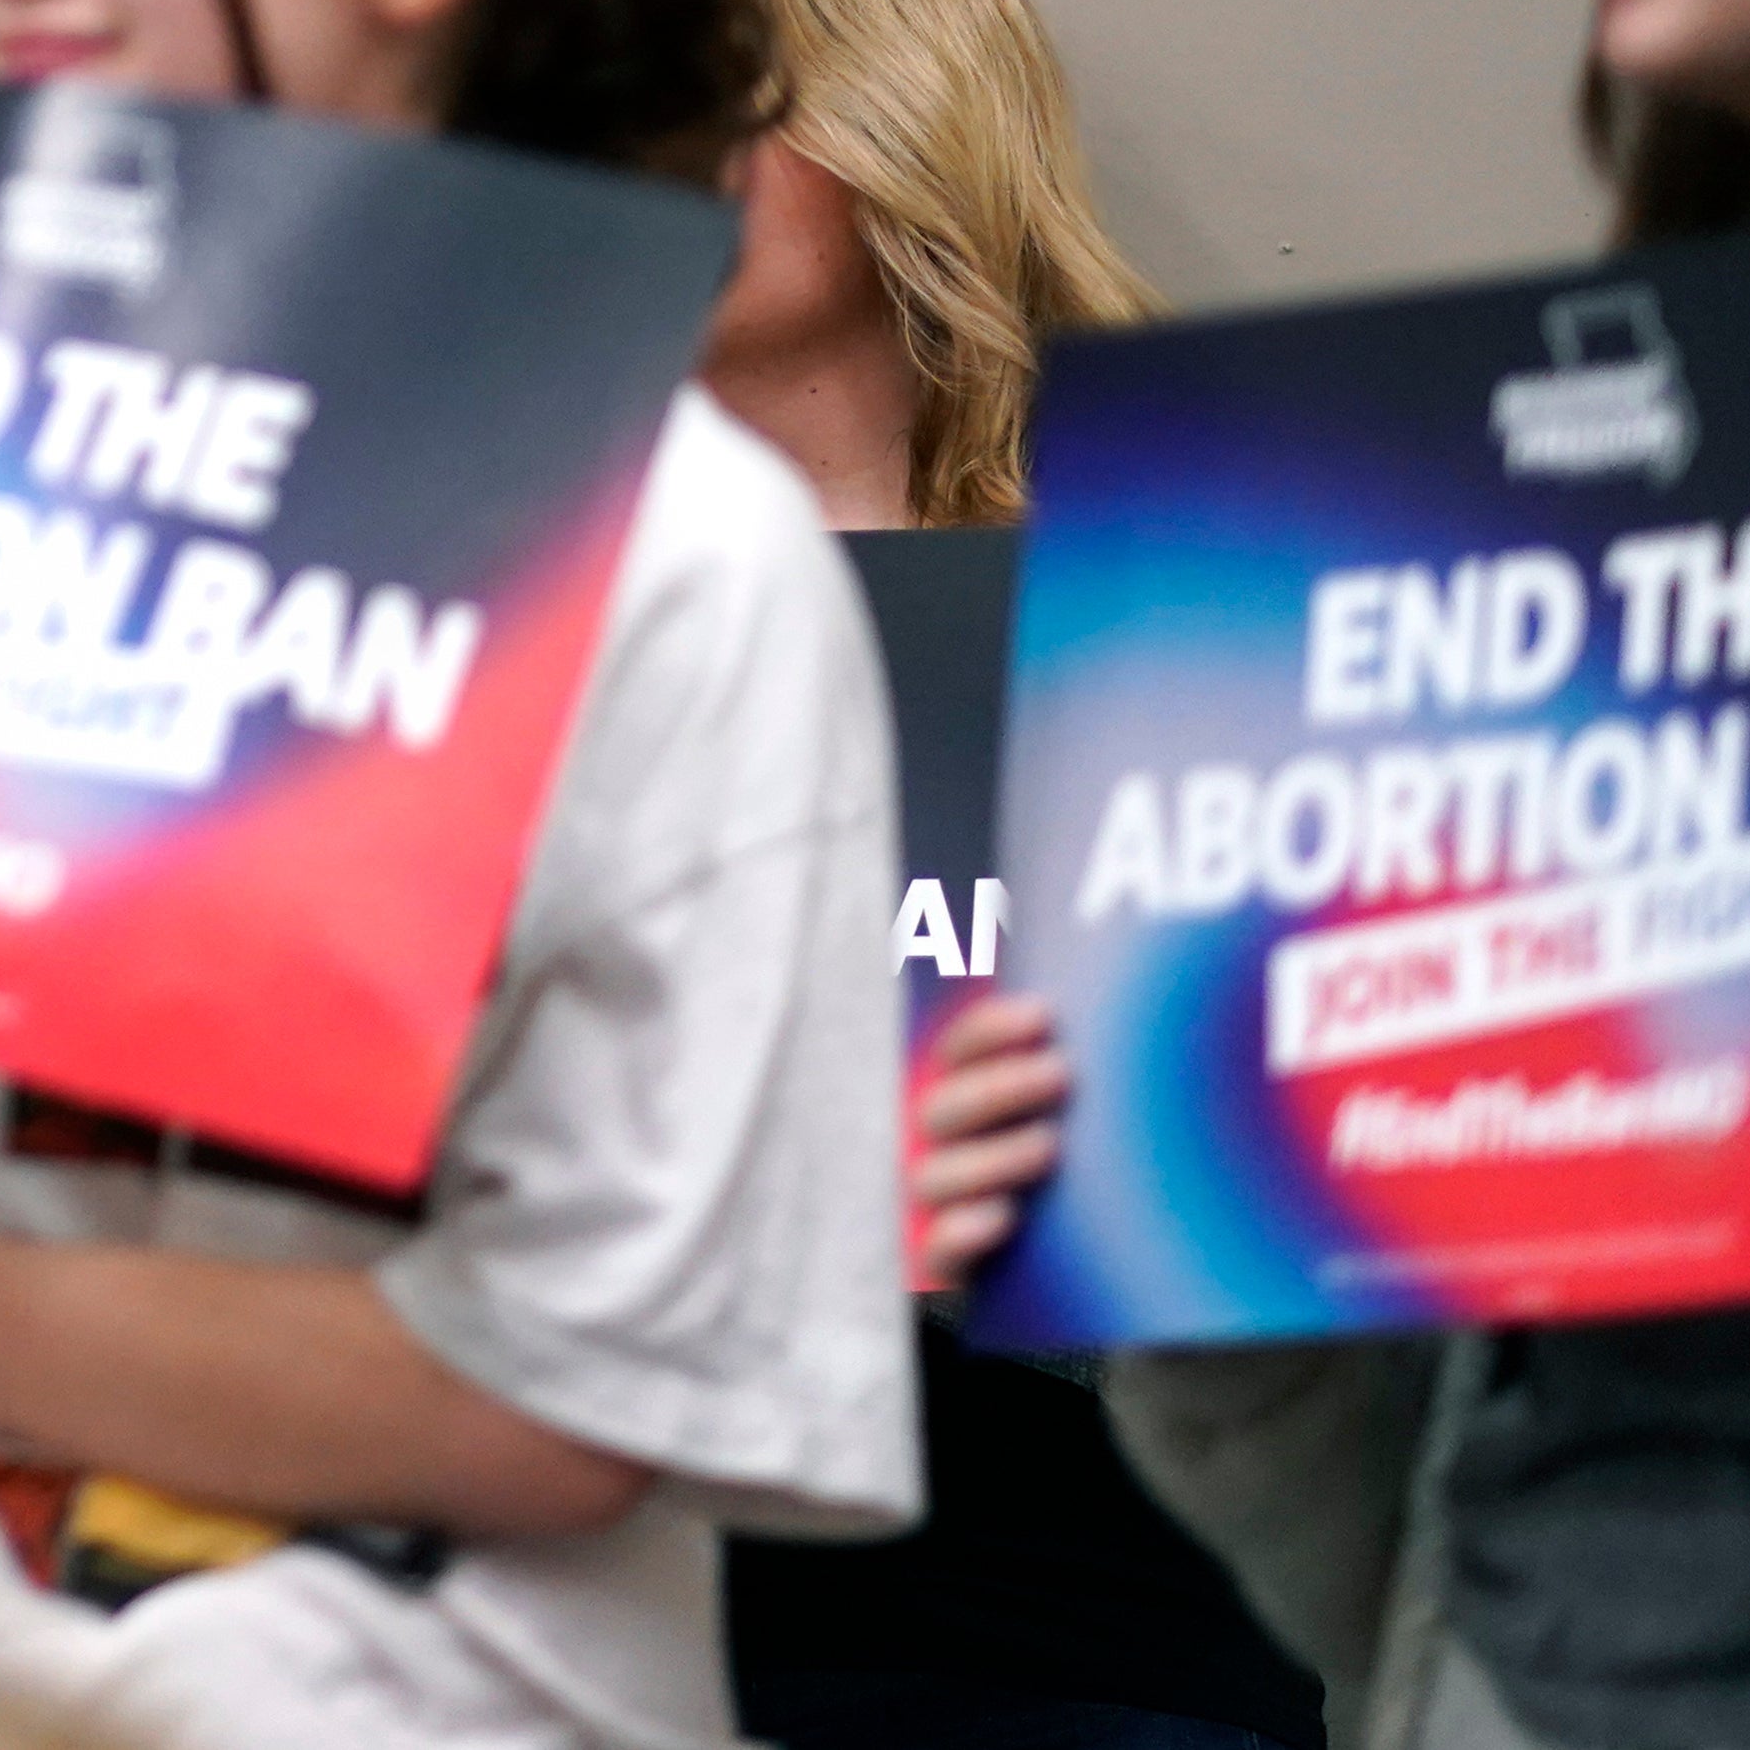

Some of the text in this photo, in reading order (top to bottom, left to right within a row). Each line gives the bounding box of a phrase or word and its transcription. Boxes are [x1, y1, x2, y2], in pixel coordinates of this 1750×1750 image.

[31, 335, 313, 528] THE
[144, 539, 485, 752] BAN
[1306, 523, 1750, 724] END TH
[1074, 710, 1750, 923] ABORTION
[887, 878, 1011, 976] AN
